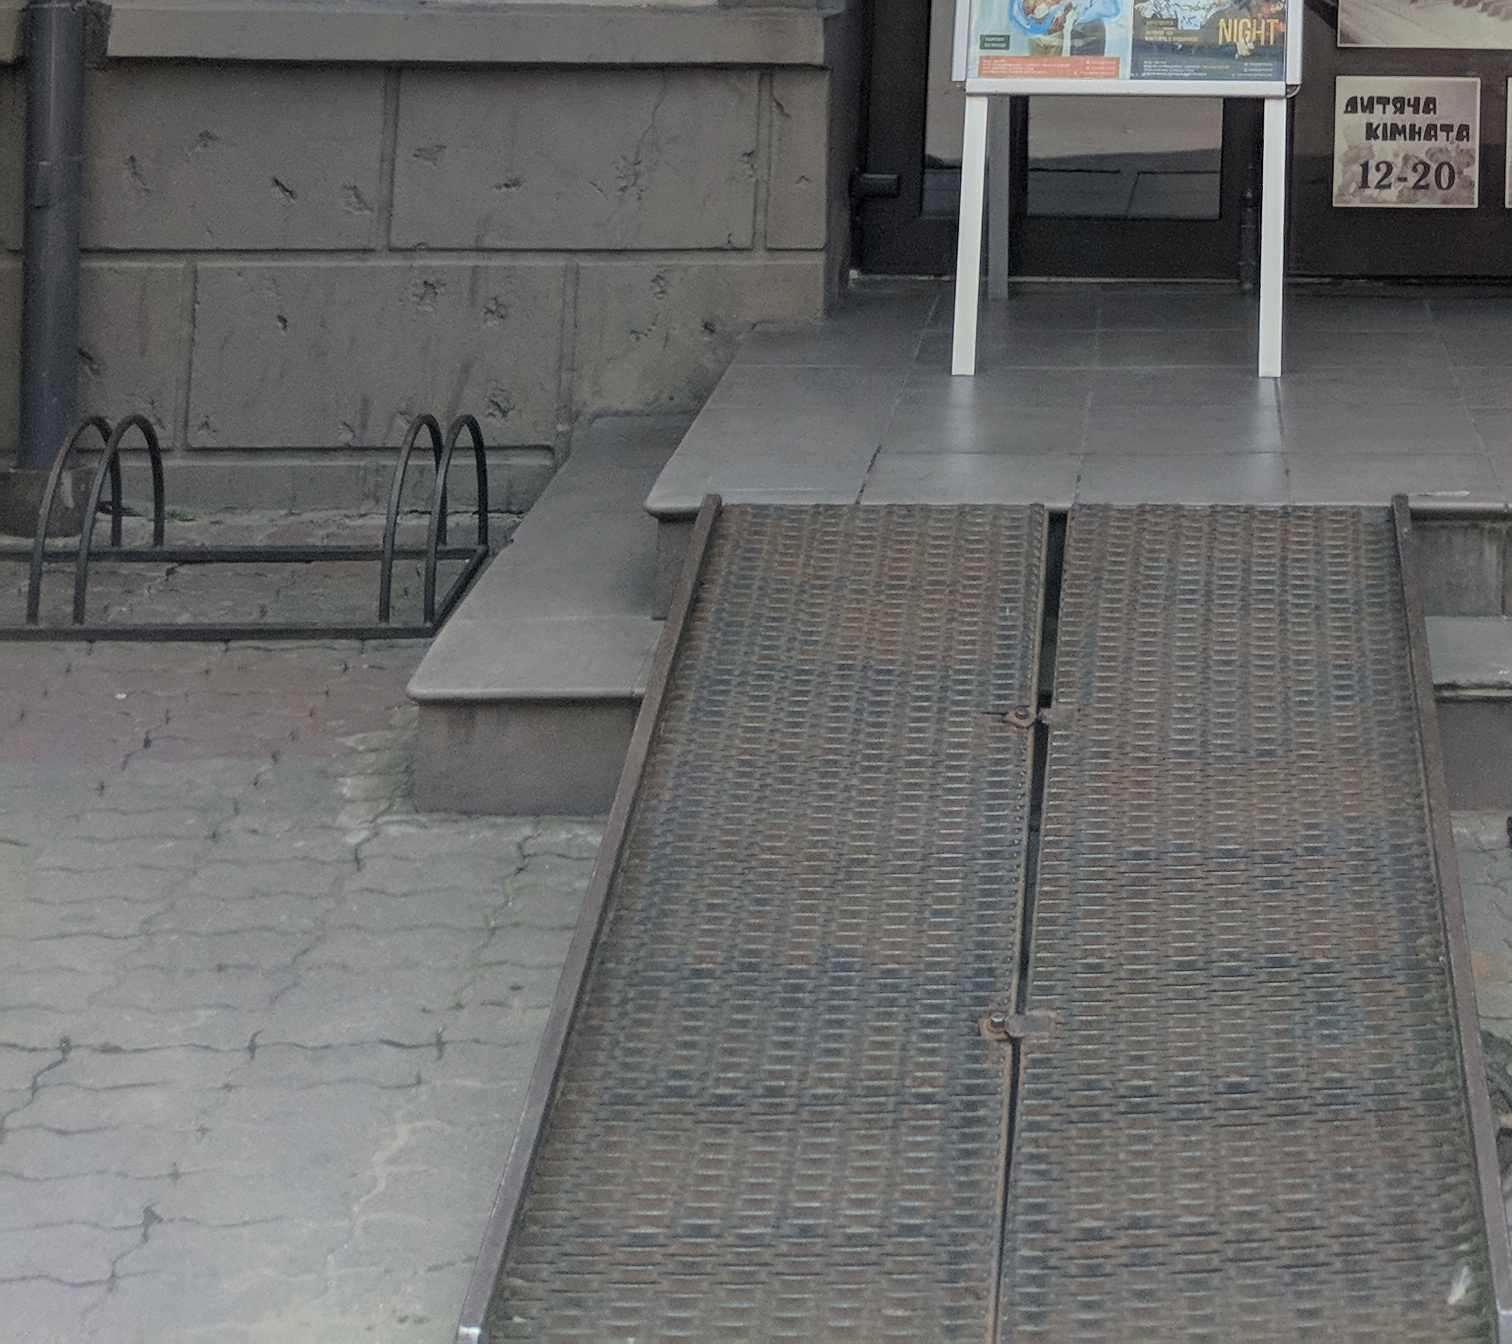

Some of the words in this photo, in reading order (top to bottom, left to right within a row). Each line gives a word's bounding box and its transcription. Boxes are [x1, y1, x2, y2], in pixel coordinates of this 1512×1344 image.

[1218, 18, 1279, 45] NIGHT
[1343, 95, 1437, 116] ДИТЯЧА
[1365, 122, 1471, 142] КІМНАТА
[1358, 160, 1456, 191] 12-20
